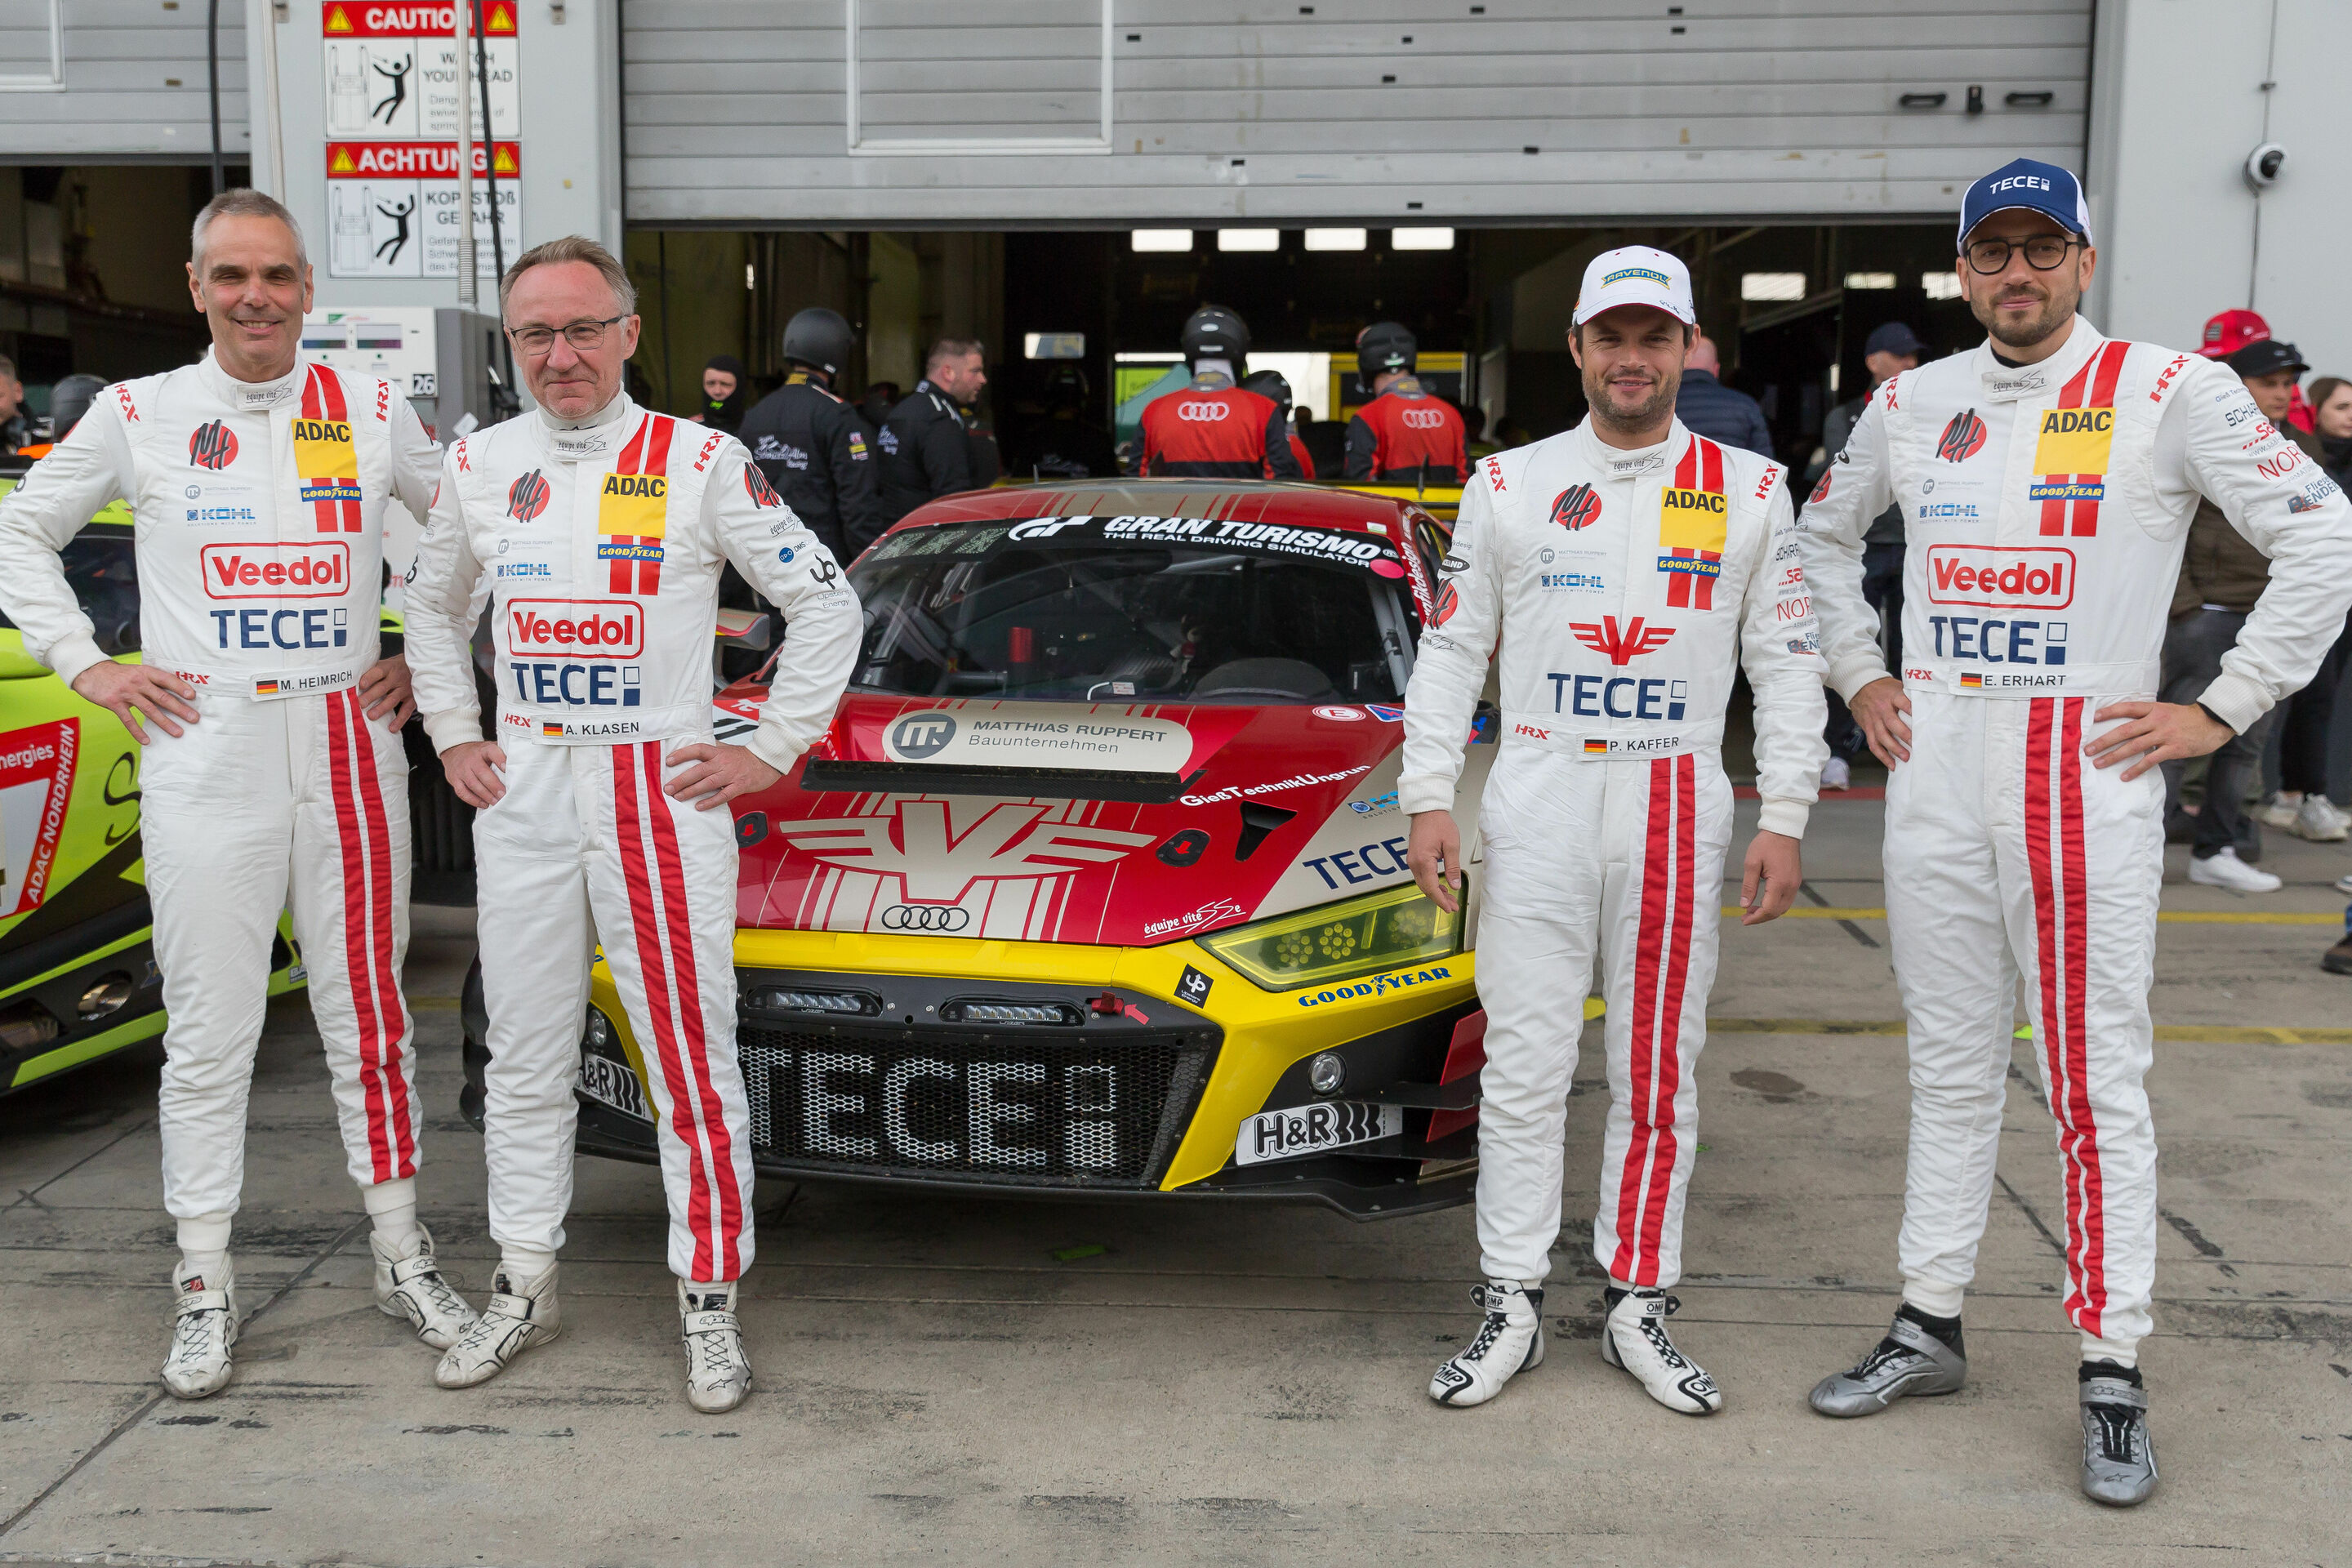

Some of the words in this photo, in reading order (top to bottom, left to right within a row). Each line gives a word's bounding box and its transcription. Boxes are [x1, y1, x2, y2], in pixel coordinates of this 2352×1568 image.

[365, 7, 473, 30] CAUTIO
[1989, 176, 2040, 194] TECE
[1607, 269, 1667, 283] RAVENOL
[414, 375, 435, 396] 26
[2149, 354, 2190, 403] HRX
[114, 383, 141, 422] HRX
[295, 421, 351, 443] ADAC
[2042, 412, 2112, 434] ADAC
[694, 431, 724, 473] HRX
[1486, 456, 1508, 492] HRX
[302, 488, 361, 499] GOODYEAR
[604, 476, 666, 497] ADAC
[2030, 487, 2103, 497] GOODYEAR
[1664, 490, 1725, 514] ADAC
[1103, 515, 1214, 535] GRAN
[599, 546, 664, 559] GOODYEAR
[1102, 532, 1139, 540] THE
[1141, 532, 1187, 542] REAL
[1190, 535, 1263, 549] DRIVING
[1267, 544, 1370, 568] SIMULATOR
[212, 554, 341, 586] Veedol
[1659, 559, 1720, 574] GOODYEAR
[1933, 558, 2063, 595] Veedol
[817, 589, 850, 600] Upsters
[822, 599, 850, 608] Energy
[210, 608, 329, 650] TECE
[512, 612, 634, 645] Veedol
[1929, 616, 2040, 665] TECE
[281, 679, 295, 691] M.
[299, 670, 353, 689] HEIMRICH
[510, 662, 617, 706] TECE
[1905, 668, 1933, 681] HRX
[1984, 675, 1998, 686] E.
[2002, 675, 2067, 686] ERHART
[1547, 672, 1666, 720] TECE
[504, 712, 531, 728] HRX
[565, 724, 577, 735] A.
[581, 722, 639, 735] KLASEN
[973, 721, 1069, 733] MATTHIAS
[1076, 724, 1168, 742] RUPPERT
[1515, 724, 1552, 741] HRX
[969, 734, 1119, 754] Bauunternehmen
[1610, 740, 1623, 751] P.
[1627, 737, 1679, 751] KAFFER
[42, 723, 76, 844] NORDRHEIN
[27, 844, 52, 904] ADAC
[1144, 919, 1180, 937] équipe
[1298, 966, 1453, 1008] GOODYEAR
[1255, 1107, 1334, 1155] H&R
[1486, 1297, 1503, 1307] OMP
